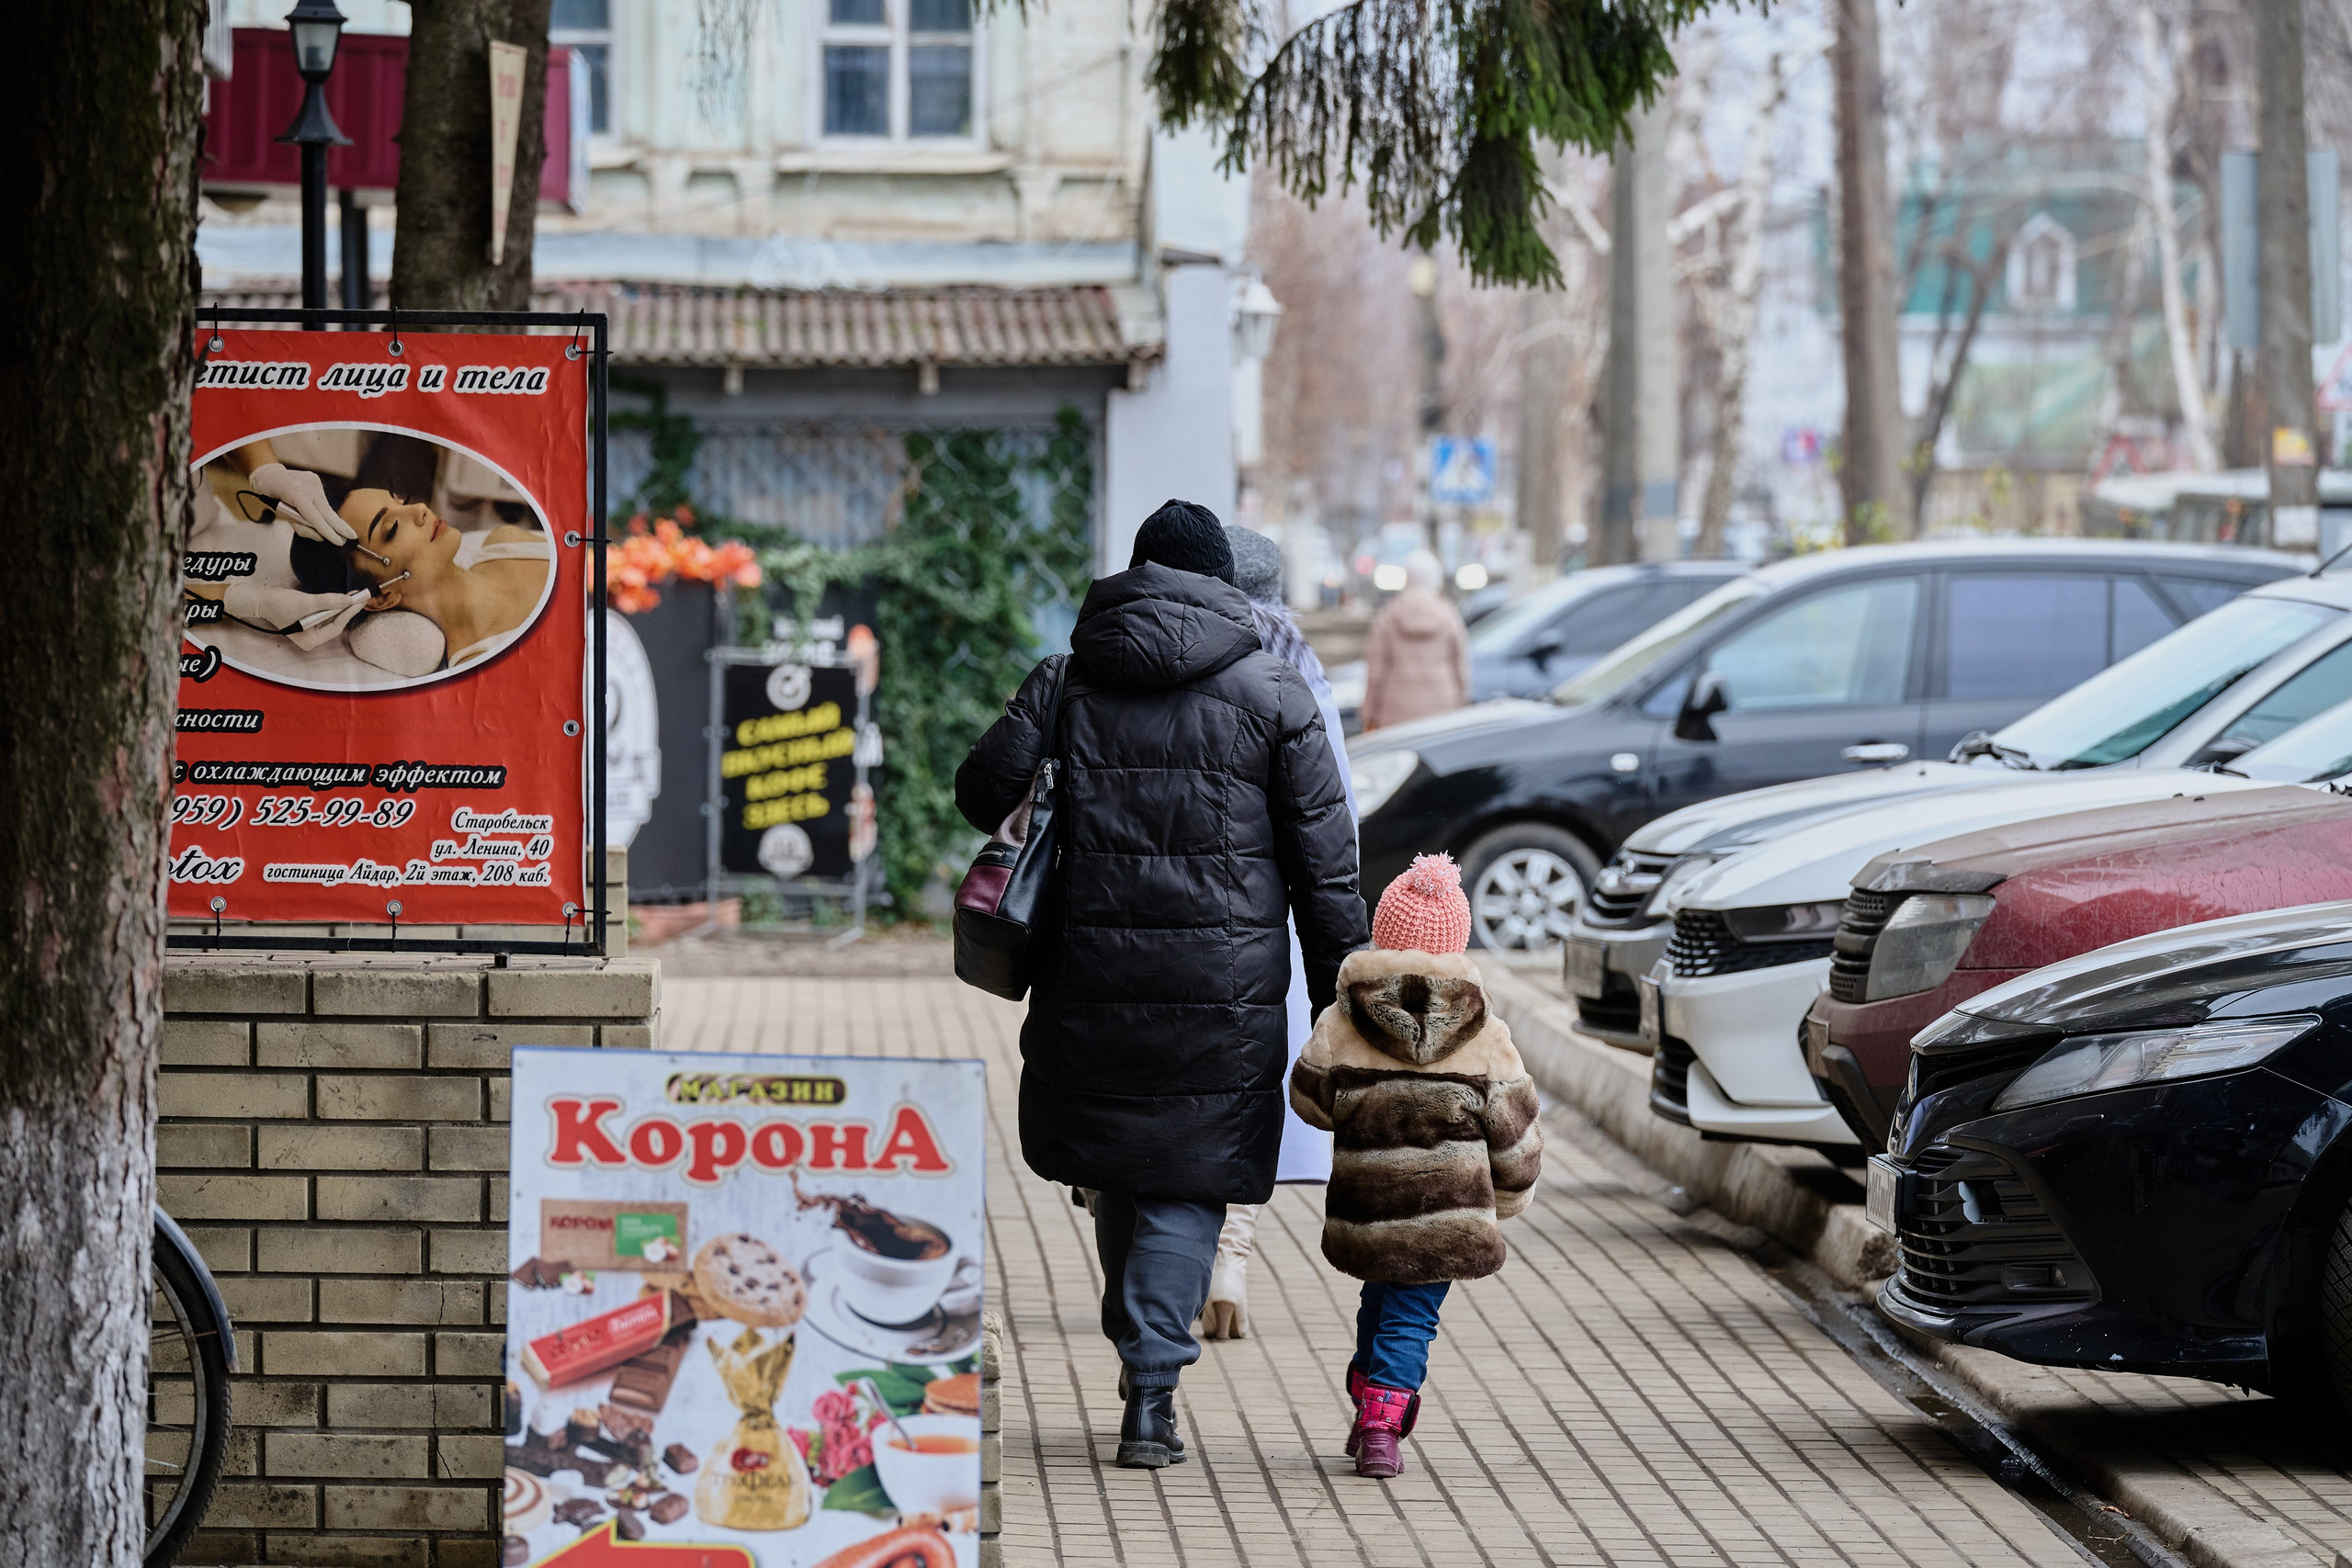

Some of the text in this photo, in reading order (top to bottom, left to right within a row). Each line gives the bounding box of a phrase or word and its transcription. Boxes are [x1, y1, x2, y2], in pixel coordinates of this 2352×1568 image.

[322, 365, 406, 395] лица
[421, 368, 444, 389] и
[458, 368, 547, 390] тела
[184, 557, 253, 576] едуры
[185, 604, 220, 627] ры
[174, 713, 260, 729] сности
[194, 764, 366, 787] охлаждающим
[375, 761, 503, 789] эффектом
[252, 798, 413, 827] 525-99-89
[455, 810, 549, 832] Старобельск
[434, 838, 550, 857] ул. Ленина, 40
[266, 862, 548, 885] гостиница Айдар, 2й этаж, 208 каб.
[551, 1100, 949, 1181] КоронА
